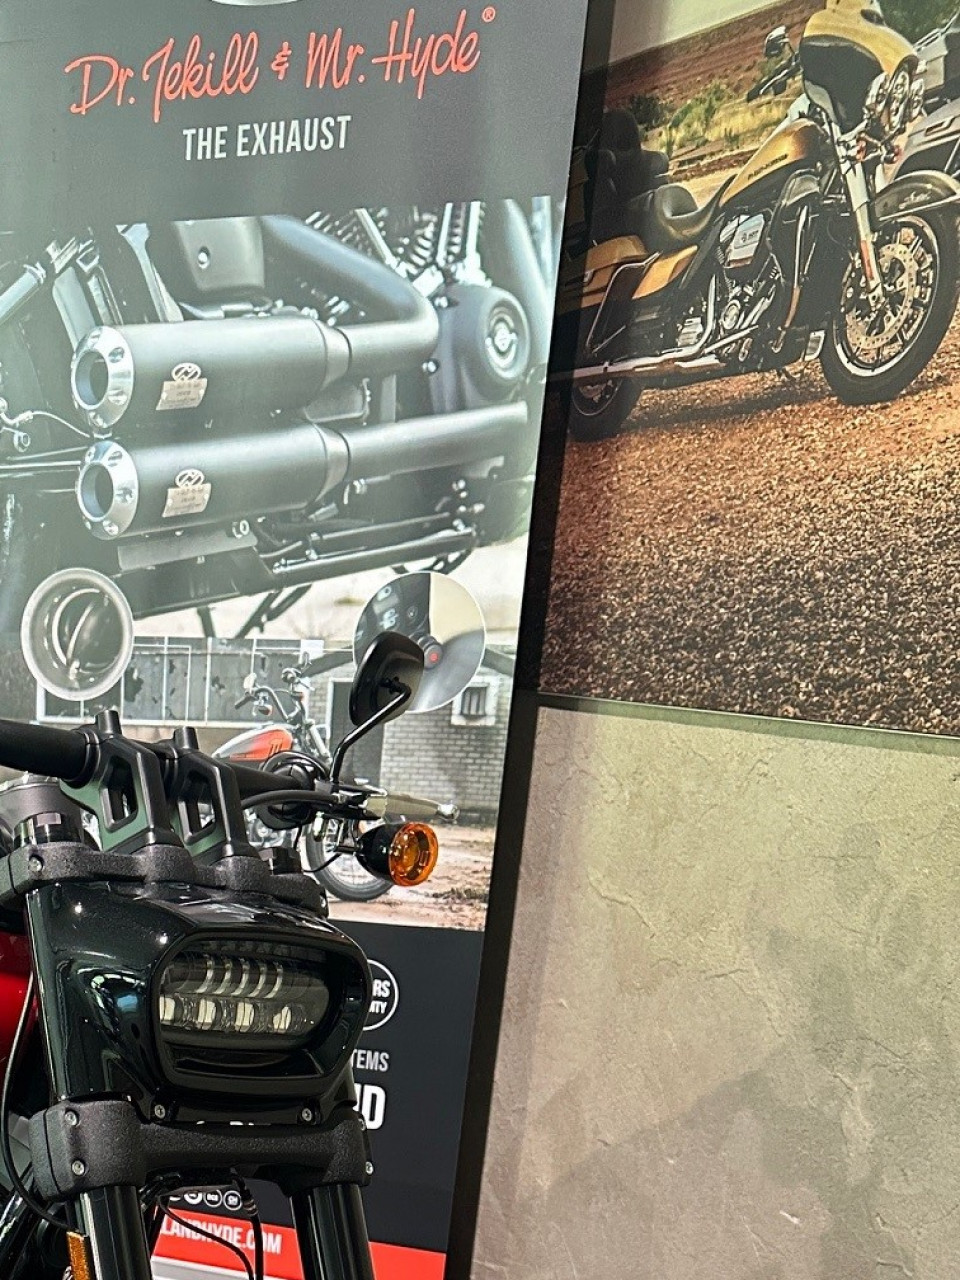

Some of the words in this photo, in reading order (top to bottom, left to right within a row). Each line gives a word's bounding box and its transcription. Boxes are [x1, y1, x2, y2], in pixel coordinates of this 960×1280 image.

[63, 54, 136, 116] Dr.
[141, 31, 260, 124] Jekill
[270, 41, 292, 81] &
[305, 27, 365, 89] Mr.
[182, 125, 229, 161] THE
[236, 114, 353, 157] EXHAUST
[160, 1212, 283, 1255] LANDHYDE.COM
